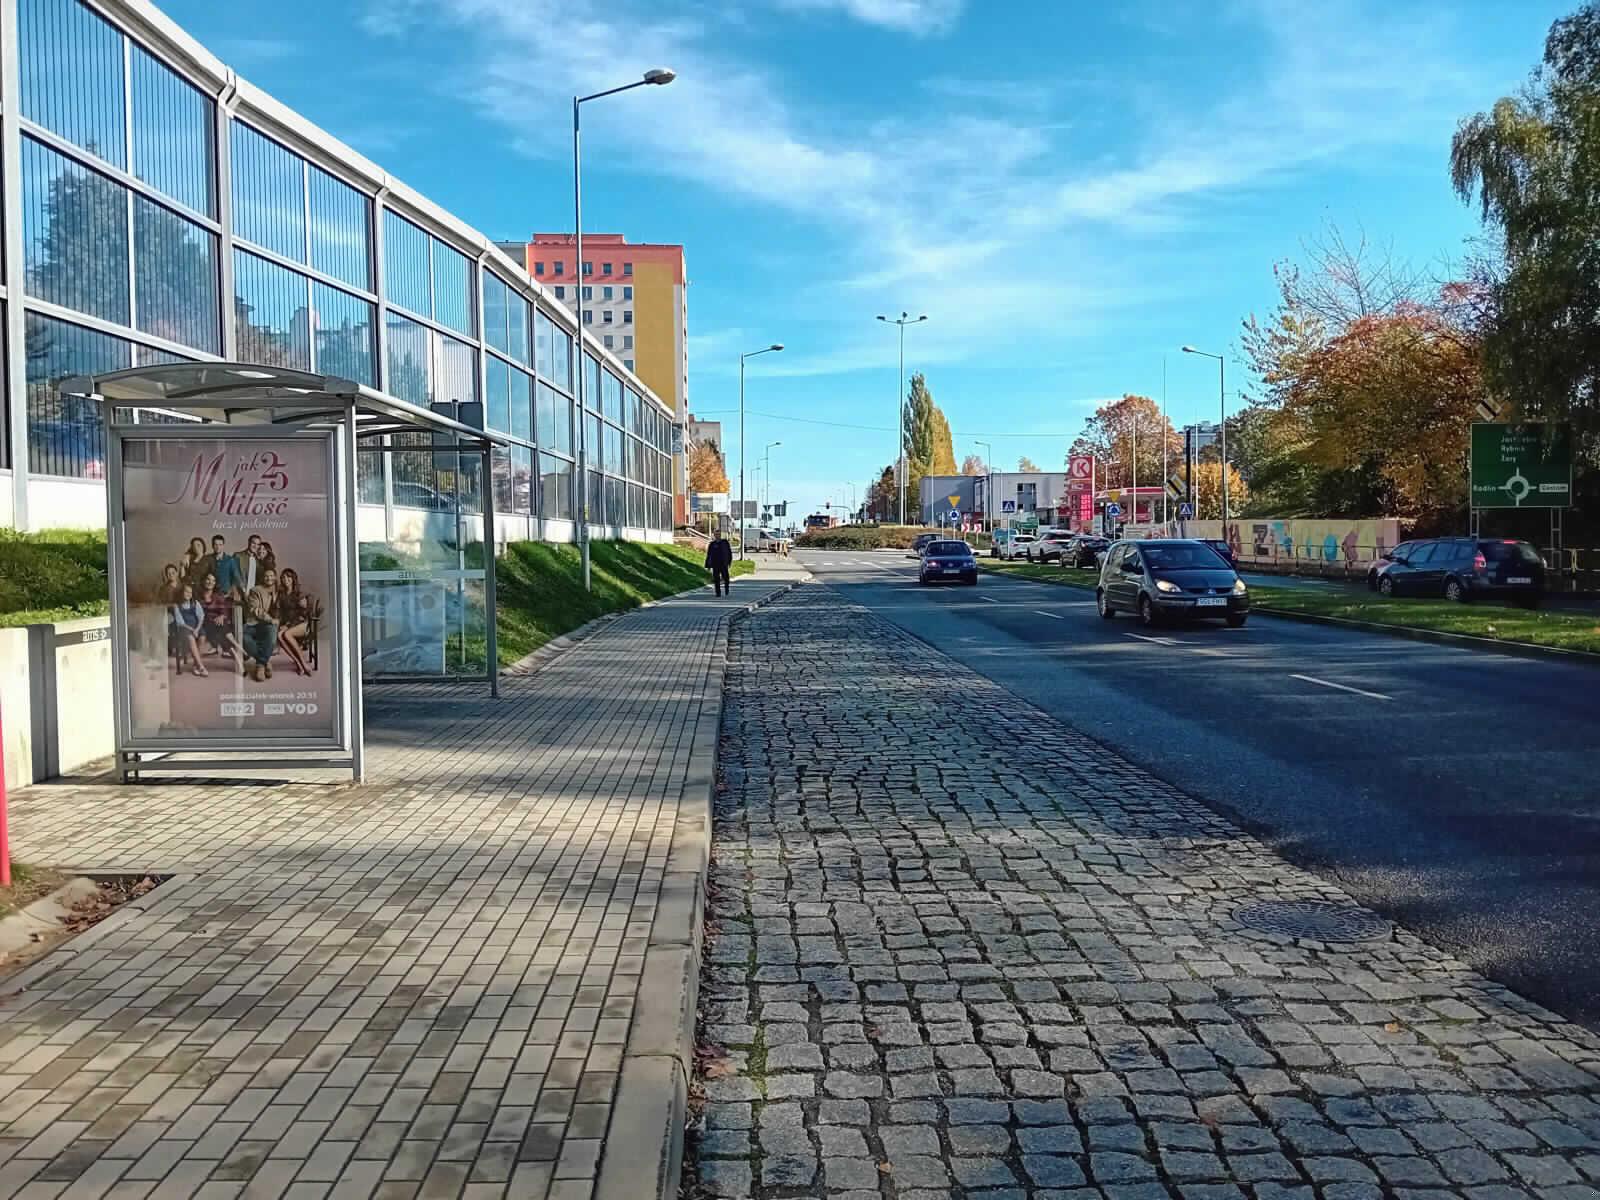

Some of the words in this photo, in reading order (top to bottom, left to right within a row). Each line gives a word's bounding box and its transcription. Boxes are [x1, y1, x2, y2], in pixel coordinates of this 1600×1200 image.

[165, 451, 225, 504] M
[233, 452, 260, 478] jak
[261, 451, 288, 490] 25
[200, 477, 288, 516] Miłość
[286, 703, 318, 714] VOD
